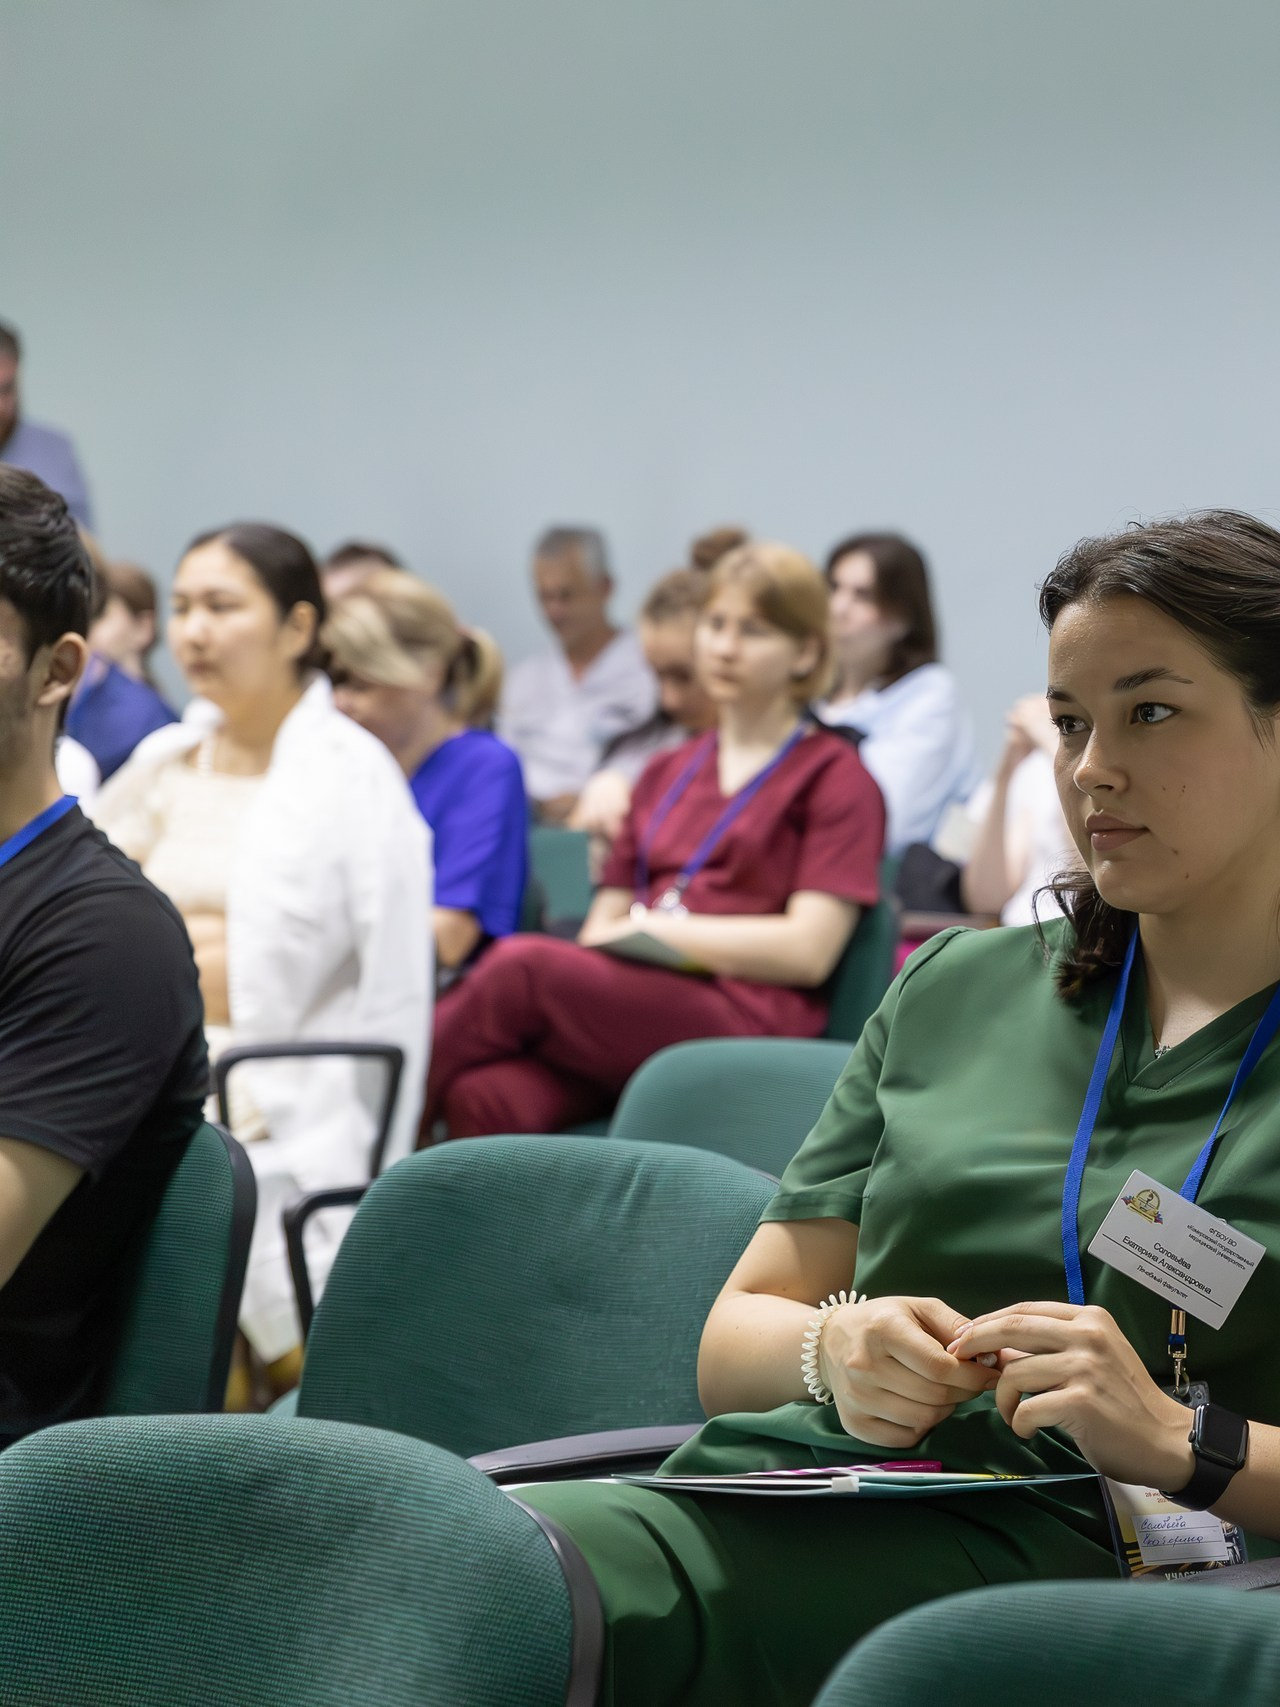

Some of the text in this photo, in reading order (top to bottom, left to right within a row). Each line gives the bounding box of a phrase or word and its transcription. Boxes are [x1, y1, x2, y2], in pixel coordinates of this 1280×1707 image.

[1208, 1227, 1238, 1248] ФГБОУ ВО
[1122, 1235, 1213, 1295] Екатерина Александровна
[1153, 1242, 1192, 1270] Соловьёва
